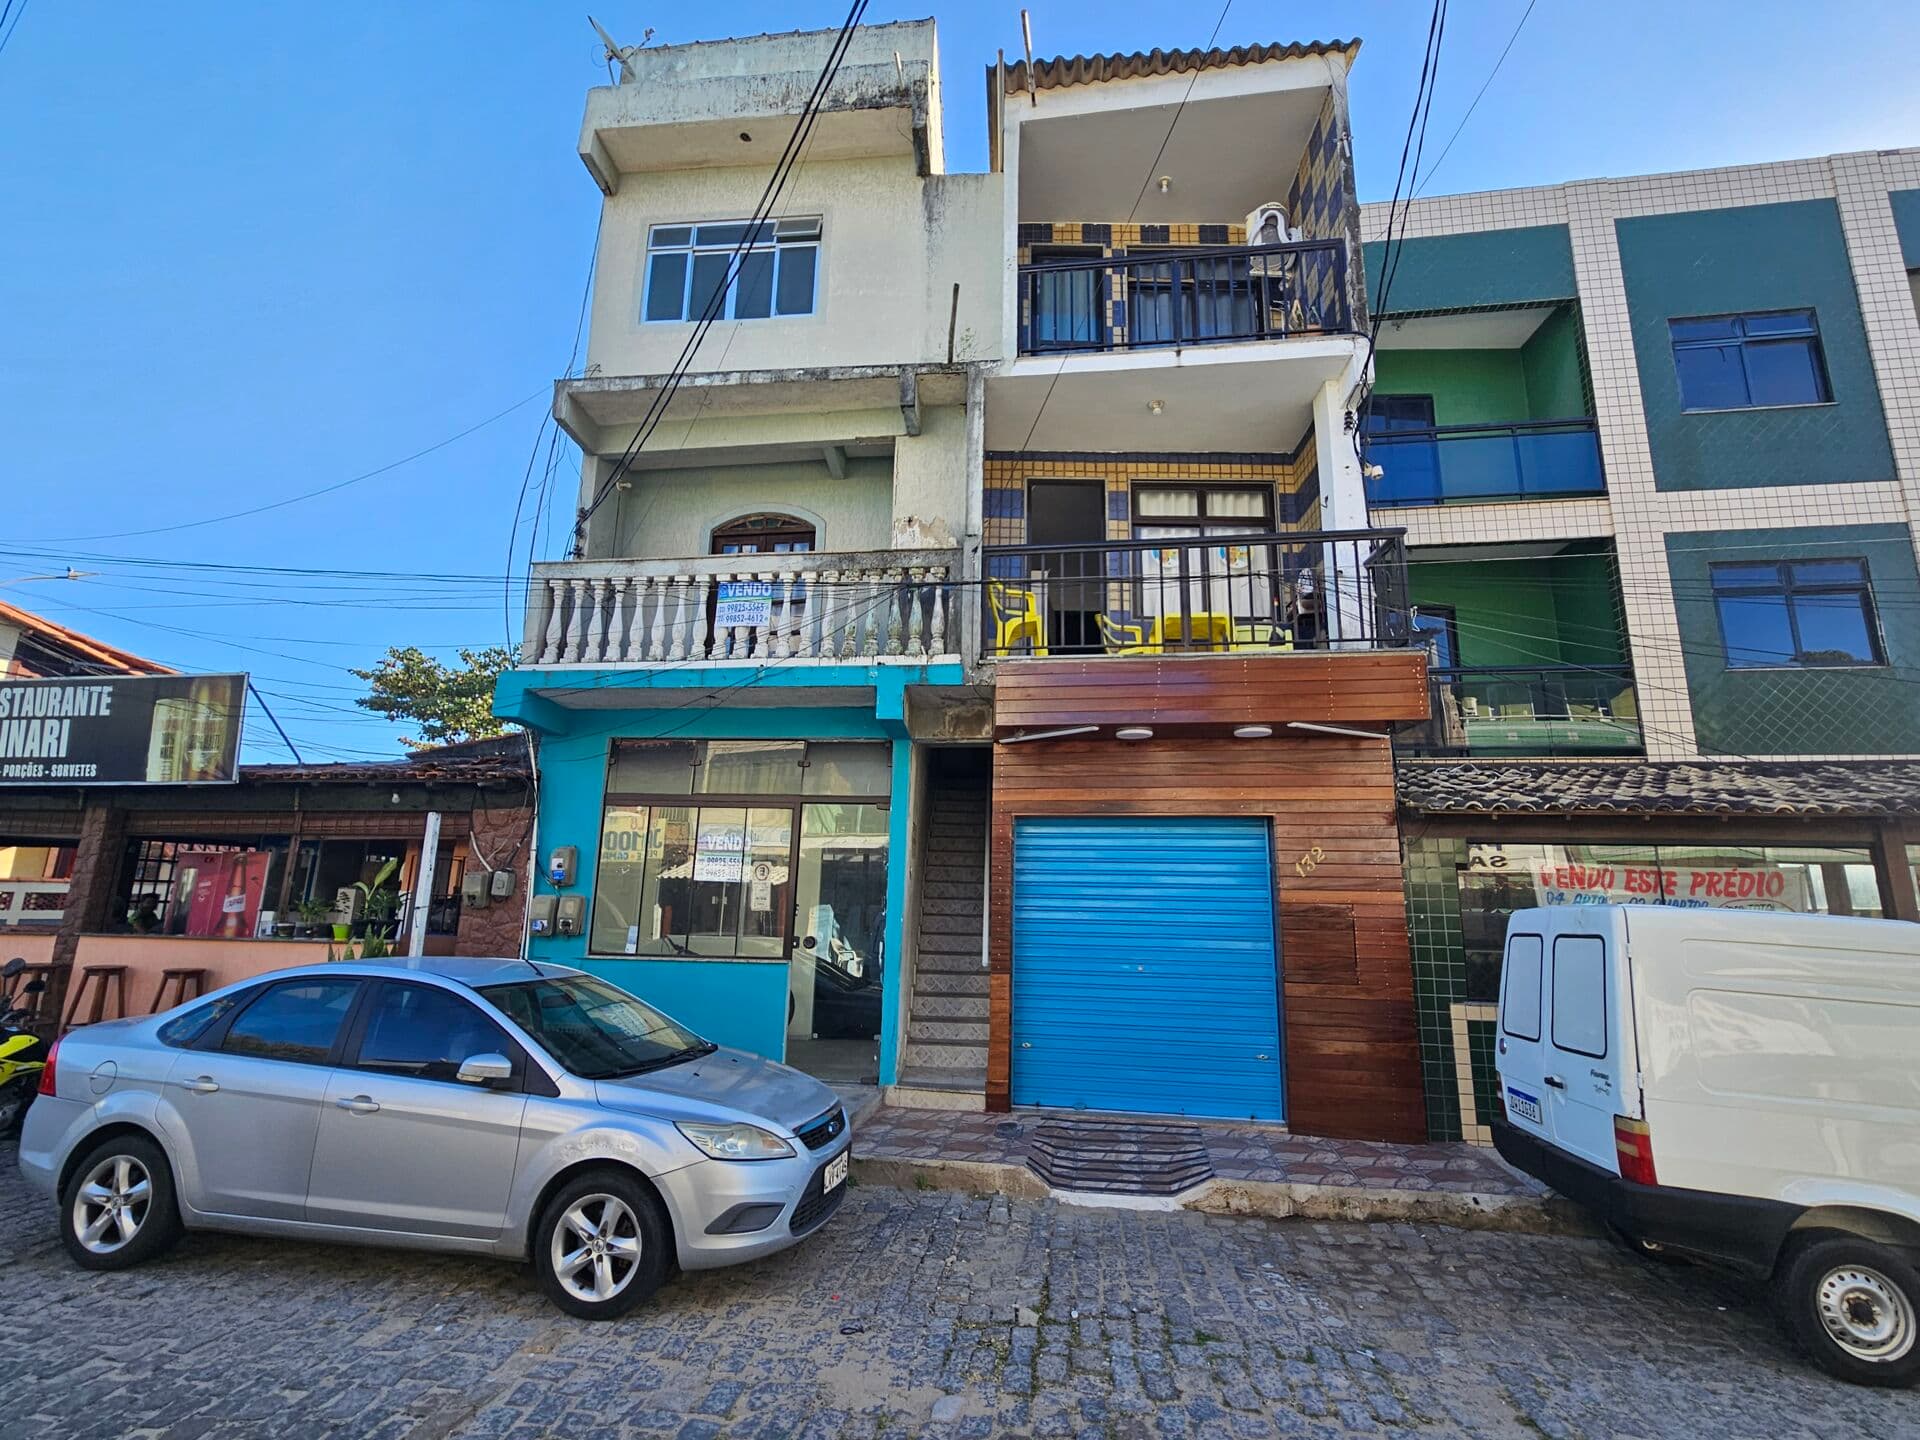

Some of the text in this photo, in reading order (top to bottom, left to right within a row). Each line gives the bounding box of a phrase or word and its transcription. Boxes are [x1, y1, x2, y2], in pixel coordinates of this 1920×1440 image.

[728, 583, 771, 597] VENDO
[0, 685, 113, 718] STAURANTE
[0, 719, 71, 758] INARI
[3, 762, 43, 778] PORÇÕES
[51, 764, 97, 777] SORVETES
[1295, 846, 1326, 878] 132
[1540, 864, 1785, 898] VENDO ESTE PRÉDIO
[1546, 891, 1566, 906] 04
